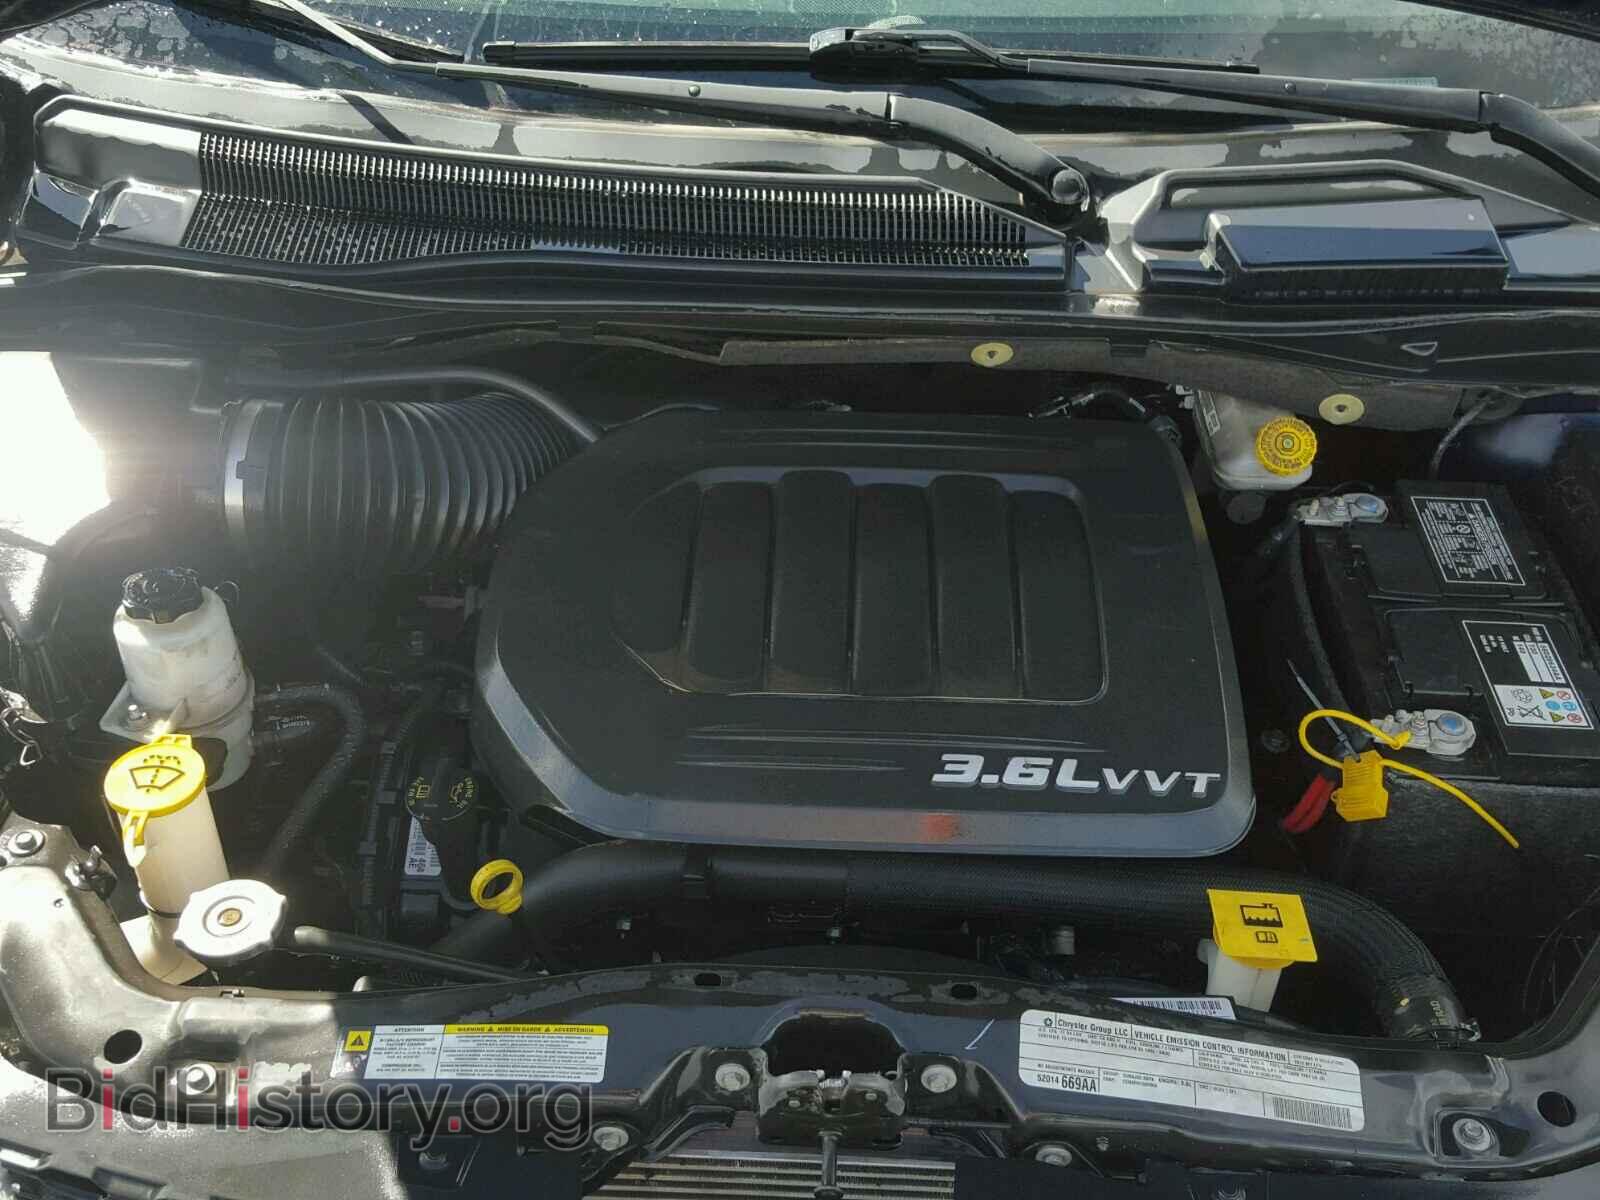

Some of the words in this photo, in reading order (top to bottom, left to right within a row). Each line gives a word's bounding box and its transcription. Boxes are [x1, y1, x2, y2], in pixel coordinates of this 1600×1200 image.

[931, 753, 1100, 794] 3.6L
[1102, 767, 1221, 799] VVT
[1057, 1018, 1088, 1030] Chrysler
[1090, 1023, 1112, 1035] Group
[1114, 1027, 1128, 1036] LLC
[1134, 1030, 1163, 1042] VEHICLE
[1166, 1035, 1200, 1048] EMISSION
[1202, 1041, 1234, 1054] CONTROL
[1237, 1047, 1286, 1061] INFORMATION
[1037, 1073, 1059, 1084] 52014
[1061, 1075, 1097, 1093] 669AA
